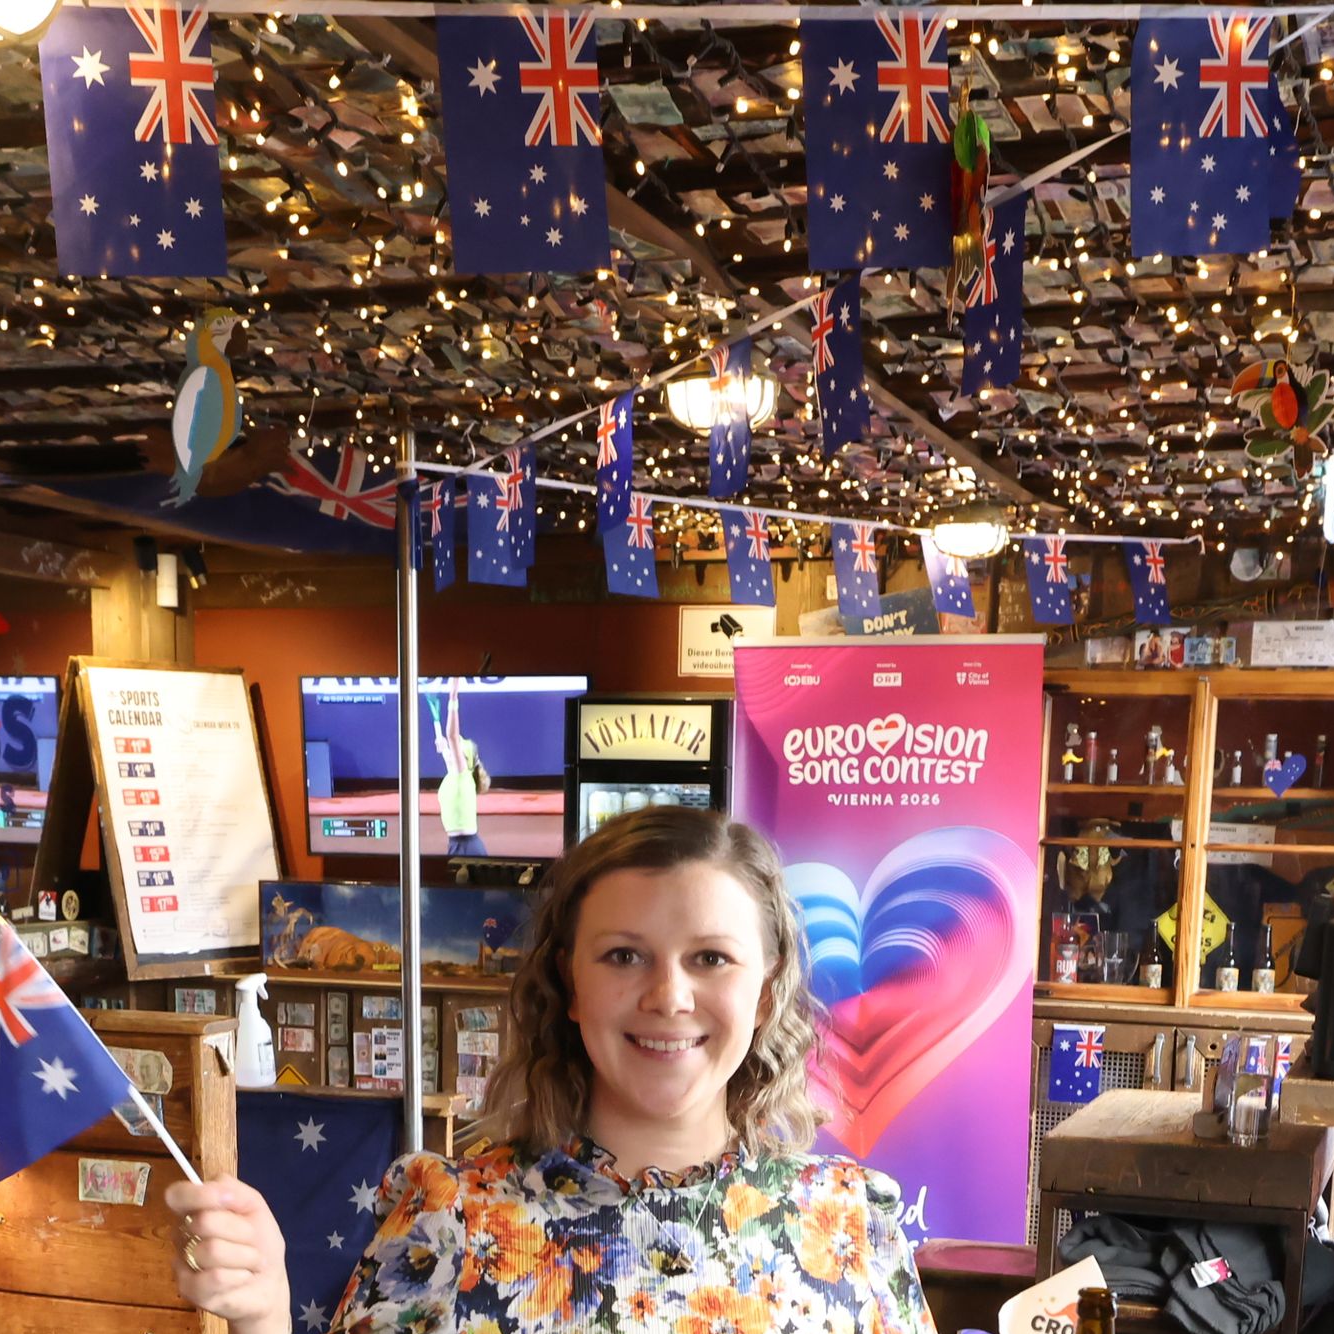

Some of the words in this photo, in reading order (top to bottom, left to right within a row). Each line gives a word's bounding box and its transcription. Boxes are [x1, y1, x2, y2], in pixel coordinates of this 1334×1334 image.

[863, 609, 907, 634] DON'T
[687, 648, 713, 657] Dieser
[714, 648, 734, 657] Bere
[801, 675, 820, 686] EBU
[875, 675, 899, 684] ORF
[968, 672, 980, 680] City
[119, 690, 160, 707] SPORTS
[108, 709, 163, 726] CALENDAR
[584, 713, 707, 756] VÖSLAUER
[788, 757, 860, 785] SONG
[863, 755, 984, 785] CONTEST
[828, 793, 894, 806] VIENNA
[900, 793, 940, 806] 2026
[1056, 959, 1077, 973] RUM
